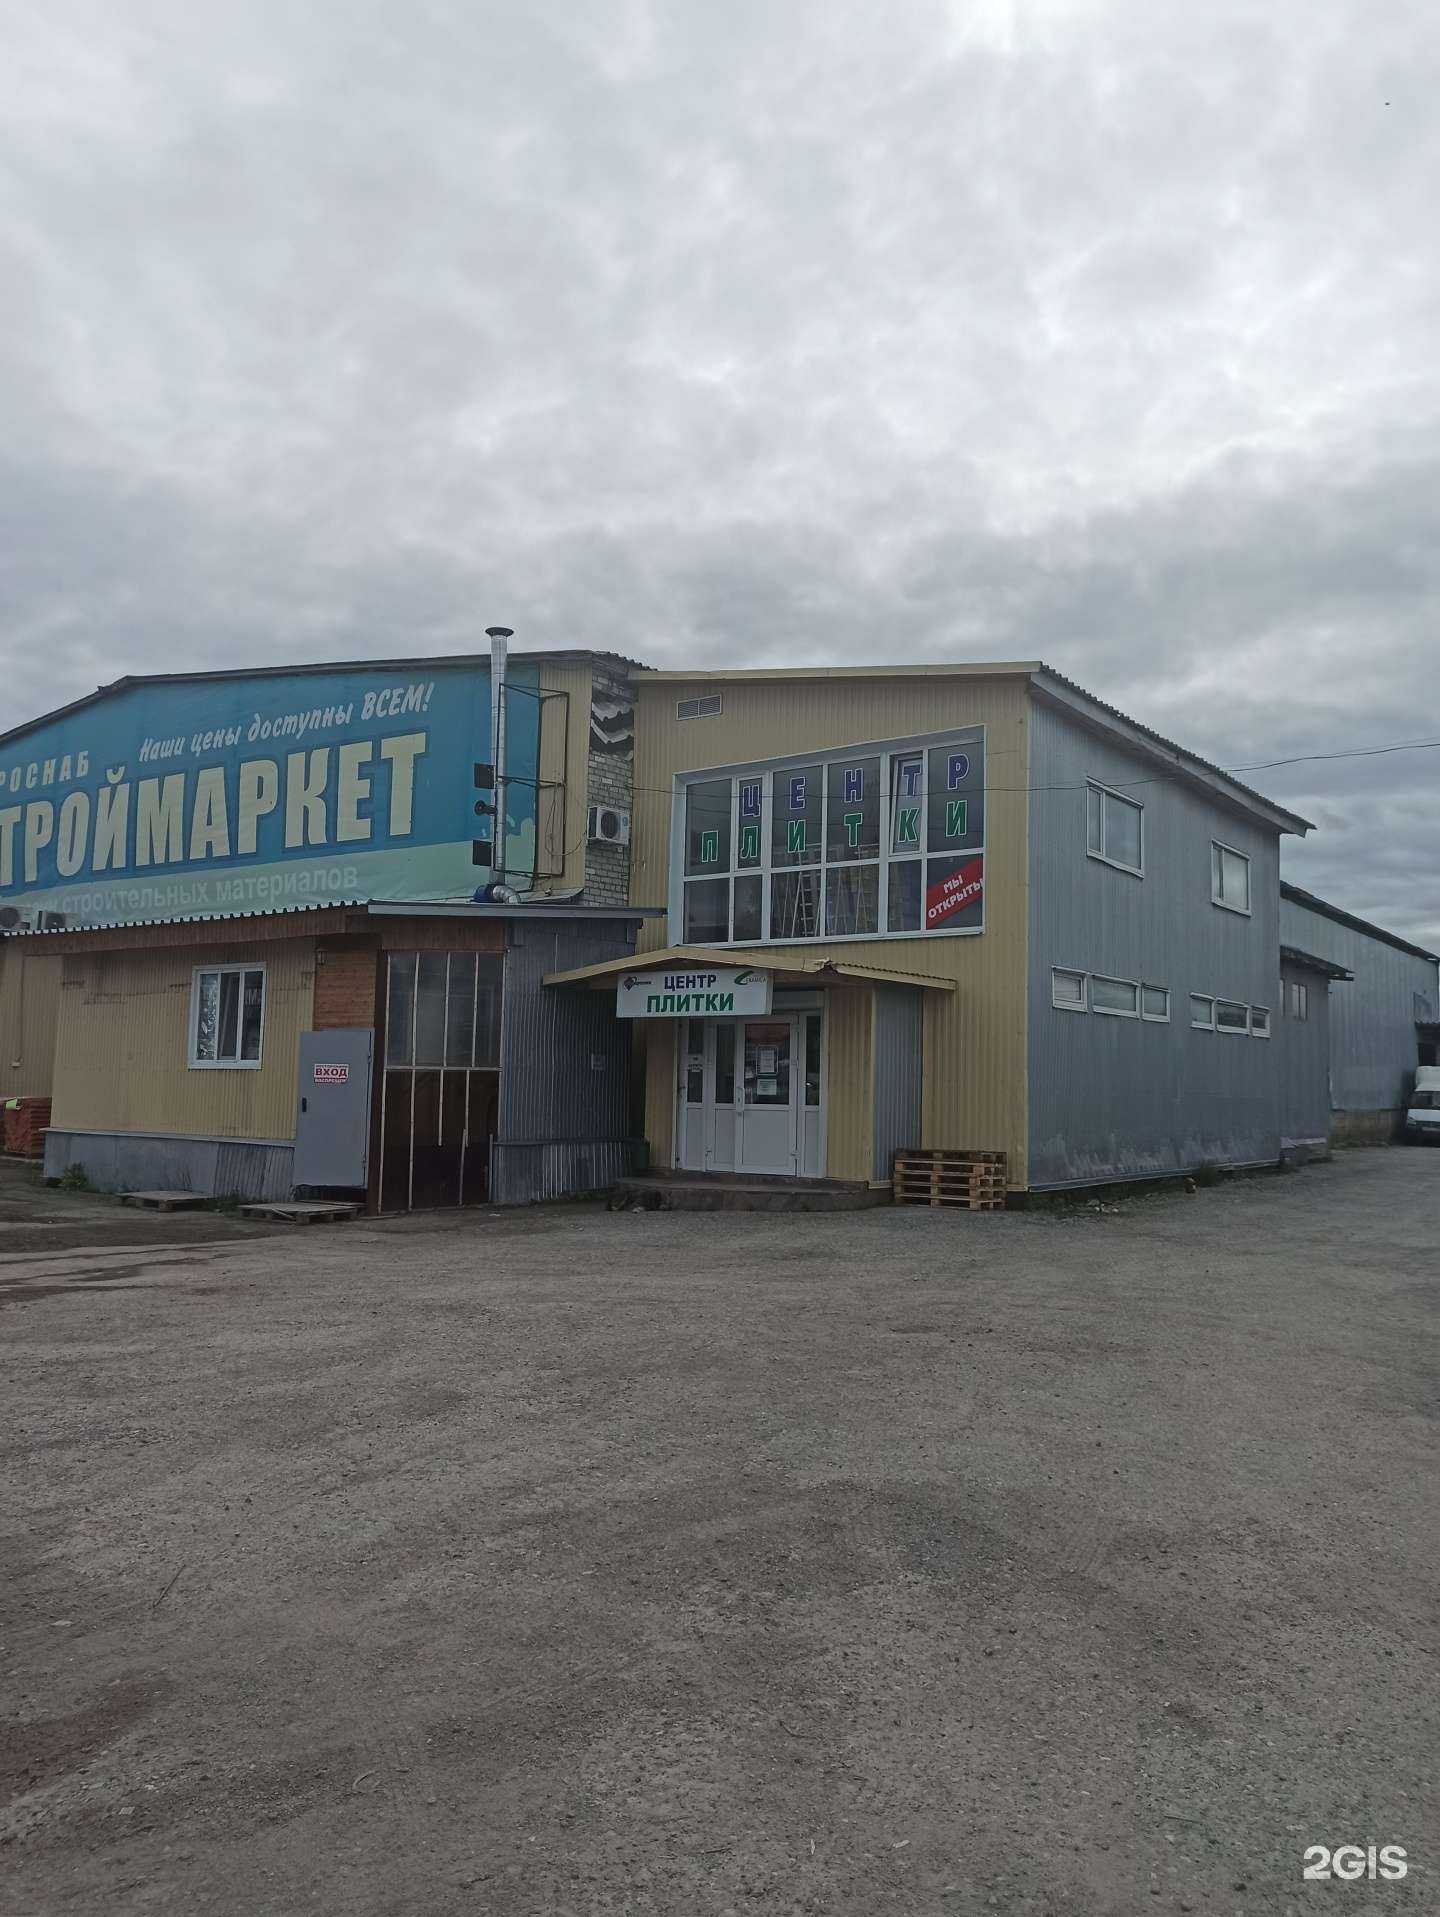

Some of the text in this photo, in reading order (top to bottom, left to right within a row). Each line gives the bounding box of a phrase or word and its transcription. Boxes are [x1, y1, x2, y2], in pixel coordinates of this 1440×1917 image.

[139, 682, 435, 762] Наши цены доступны ВСЕМ!
[742, 753, 970, 817] ЦЕНТР
[700, 800, 967, 863] ПЛИТКИ
[62, 882, 208, 915] строительных
[216, 867, 358, 902] материалов
[943, 874, 963, 894] МЫ
[664, 975, 716, 991] ЦЕНТР
[646, 992, 734, 1013] ПЛИТКИ
[315, 1068, 347, 1077] ВХОД
